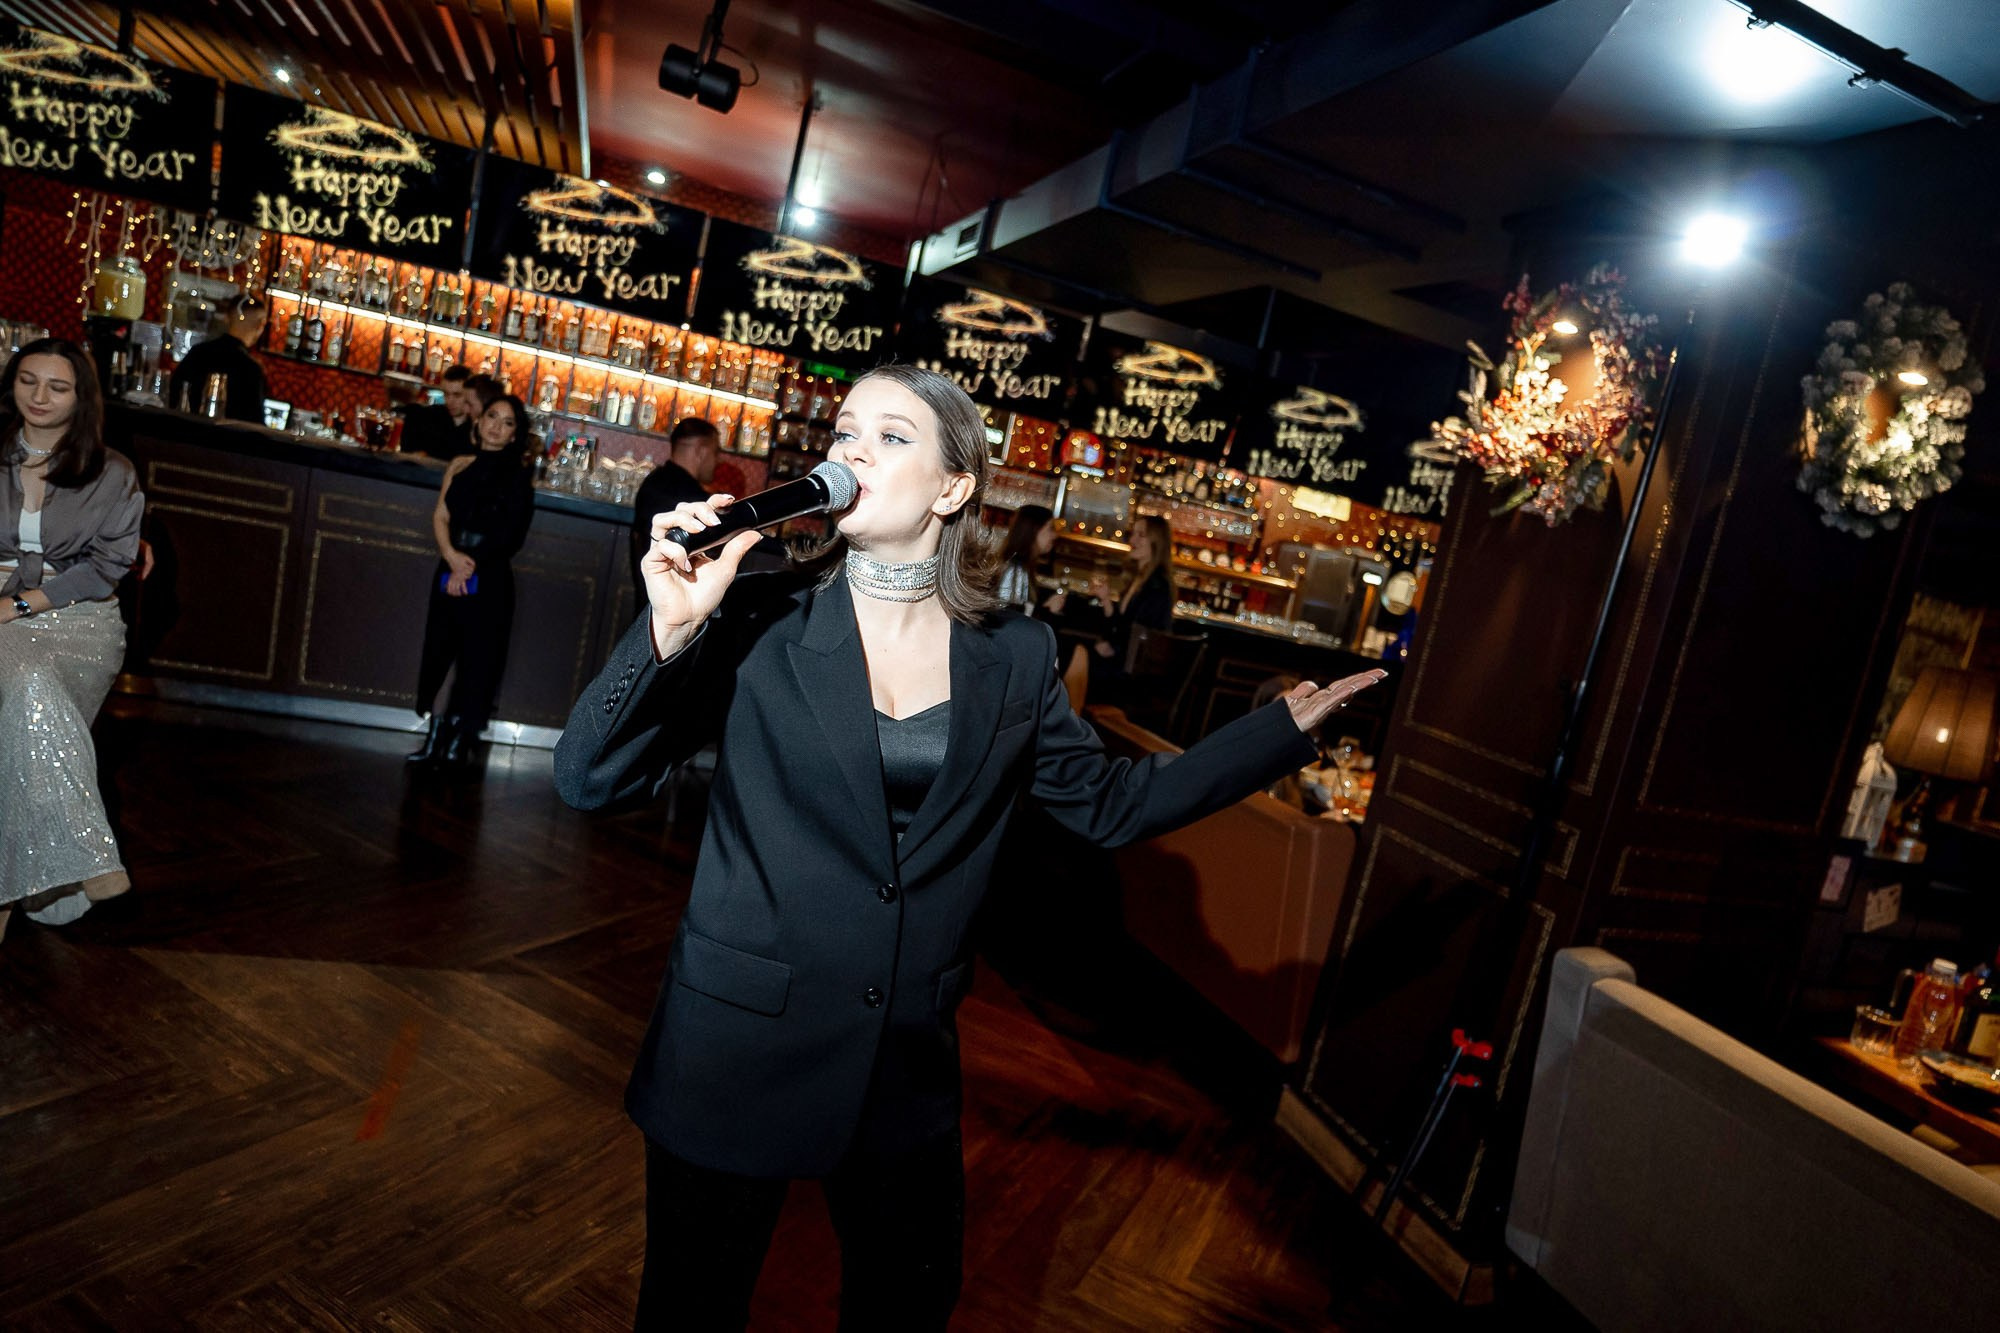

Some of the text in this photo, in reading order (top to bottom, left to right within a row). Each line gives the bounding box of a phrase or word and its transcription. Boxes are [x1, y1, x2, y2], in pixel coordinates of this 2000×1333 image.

[11, 81, 133, 139] Happy
[90, 141, 195, 180] Year
[291, 155, 400, 207] Happy
[256, 193, 452, 243] New Year
[538, 219, 636, 266] Happy
[504, 255, 681, 299] New Year
[754, 277, 845, 321] Happy
[721, 311, 883, 351] New Year
[946, 328, 1028, 370] Happy
[990, 370, 1061, 398] Year
[1125, 378, 1198, 417] Happy
[1094, 407, 1226, 443] New Year
[1276, 421, 1343, 458] Happy
[1246, 449, 1367, 481] New Year
